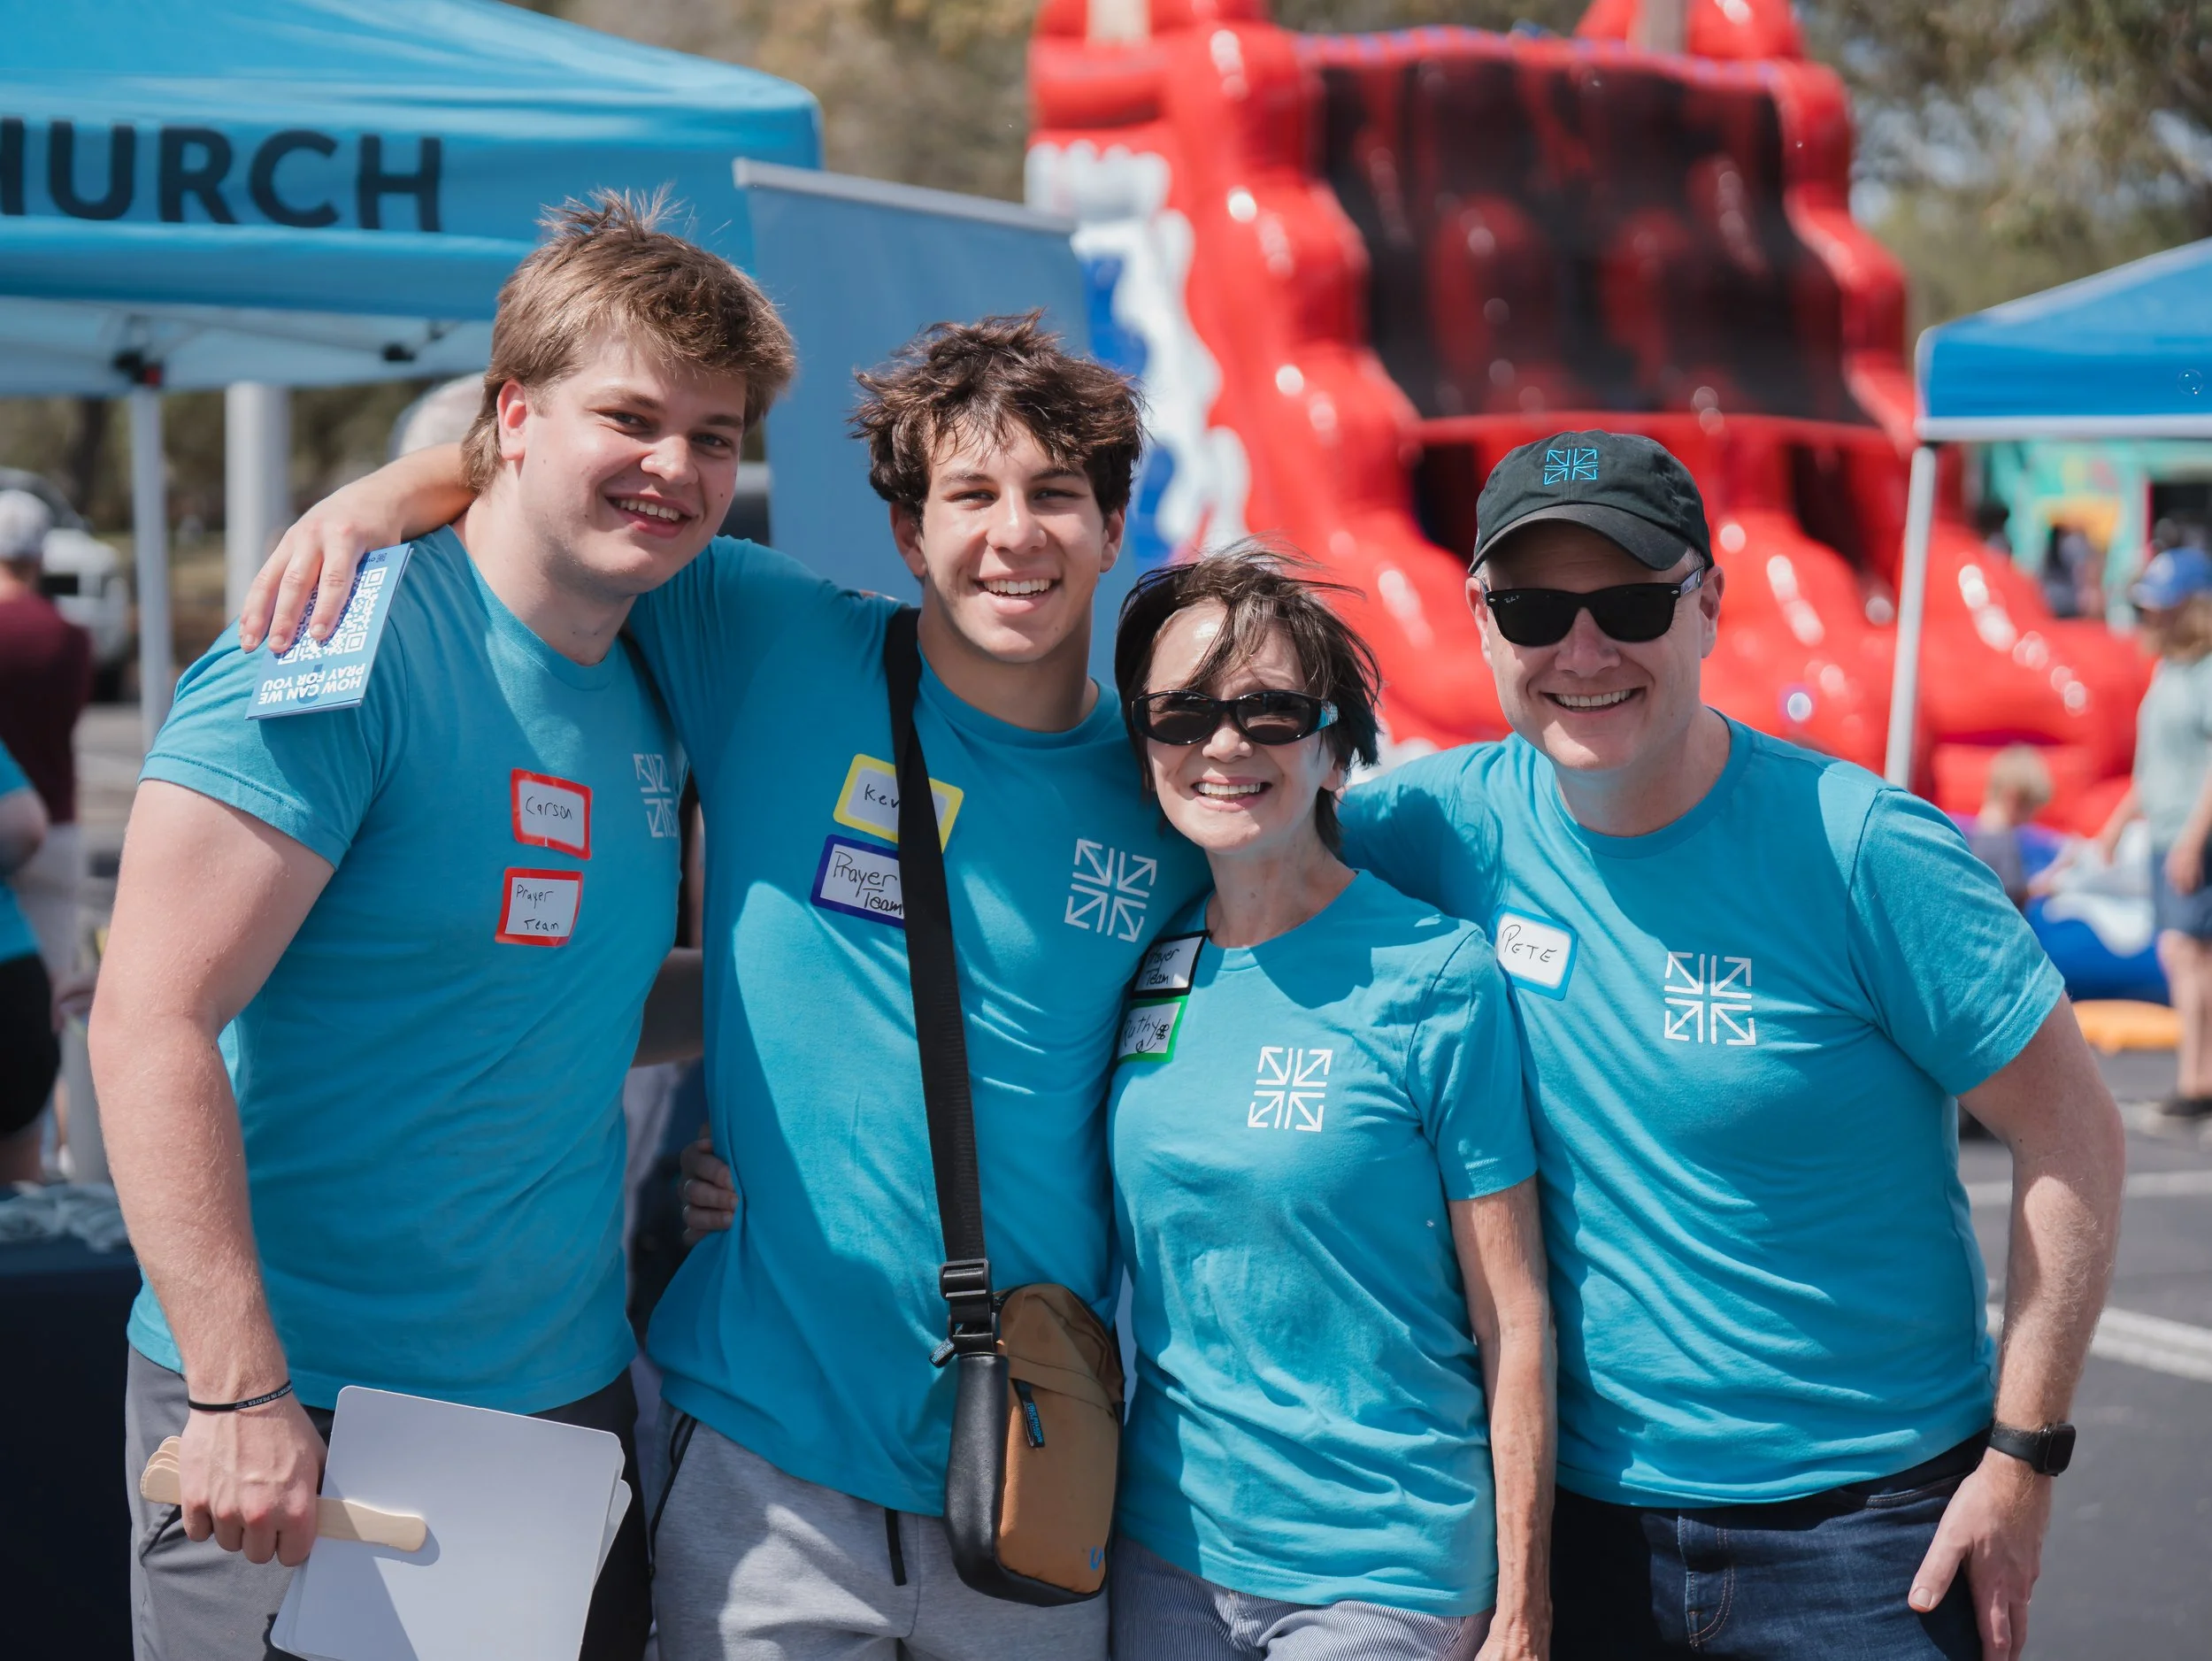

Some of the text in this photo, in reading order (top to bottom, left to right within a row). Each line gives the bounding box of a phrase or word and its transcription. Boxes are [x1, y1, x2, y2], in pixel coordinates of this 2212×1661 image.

[0, 117, 442, 233] URCH
[258, 676, 363, 705] HOW CAN WE
[262, 663, 366, 692] PRAY FOR YOU
[526, 796, 573, 820] Carson
[864, 784, 900, 808] Kev
[833, 850, 897, 897] Prayer
[516, 884, 555, 910] Prayer
[863, 888, 903, 915] Team
[524, 918, 559, 931] Team
[1502, 924, 1558, 963] PETE
[248, 1396, 270, 1406] PRAYER
